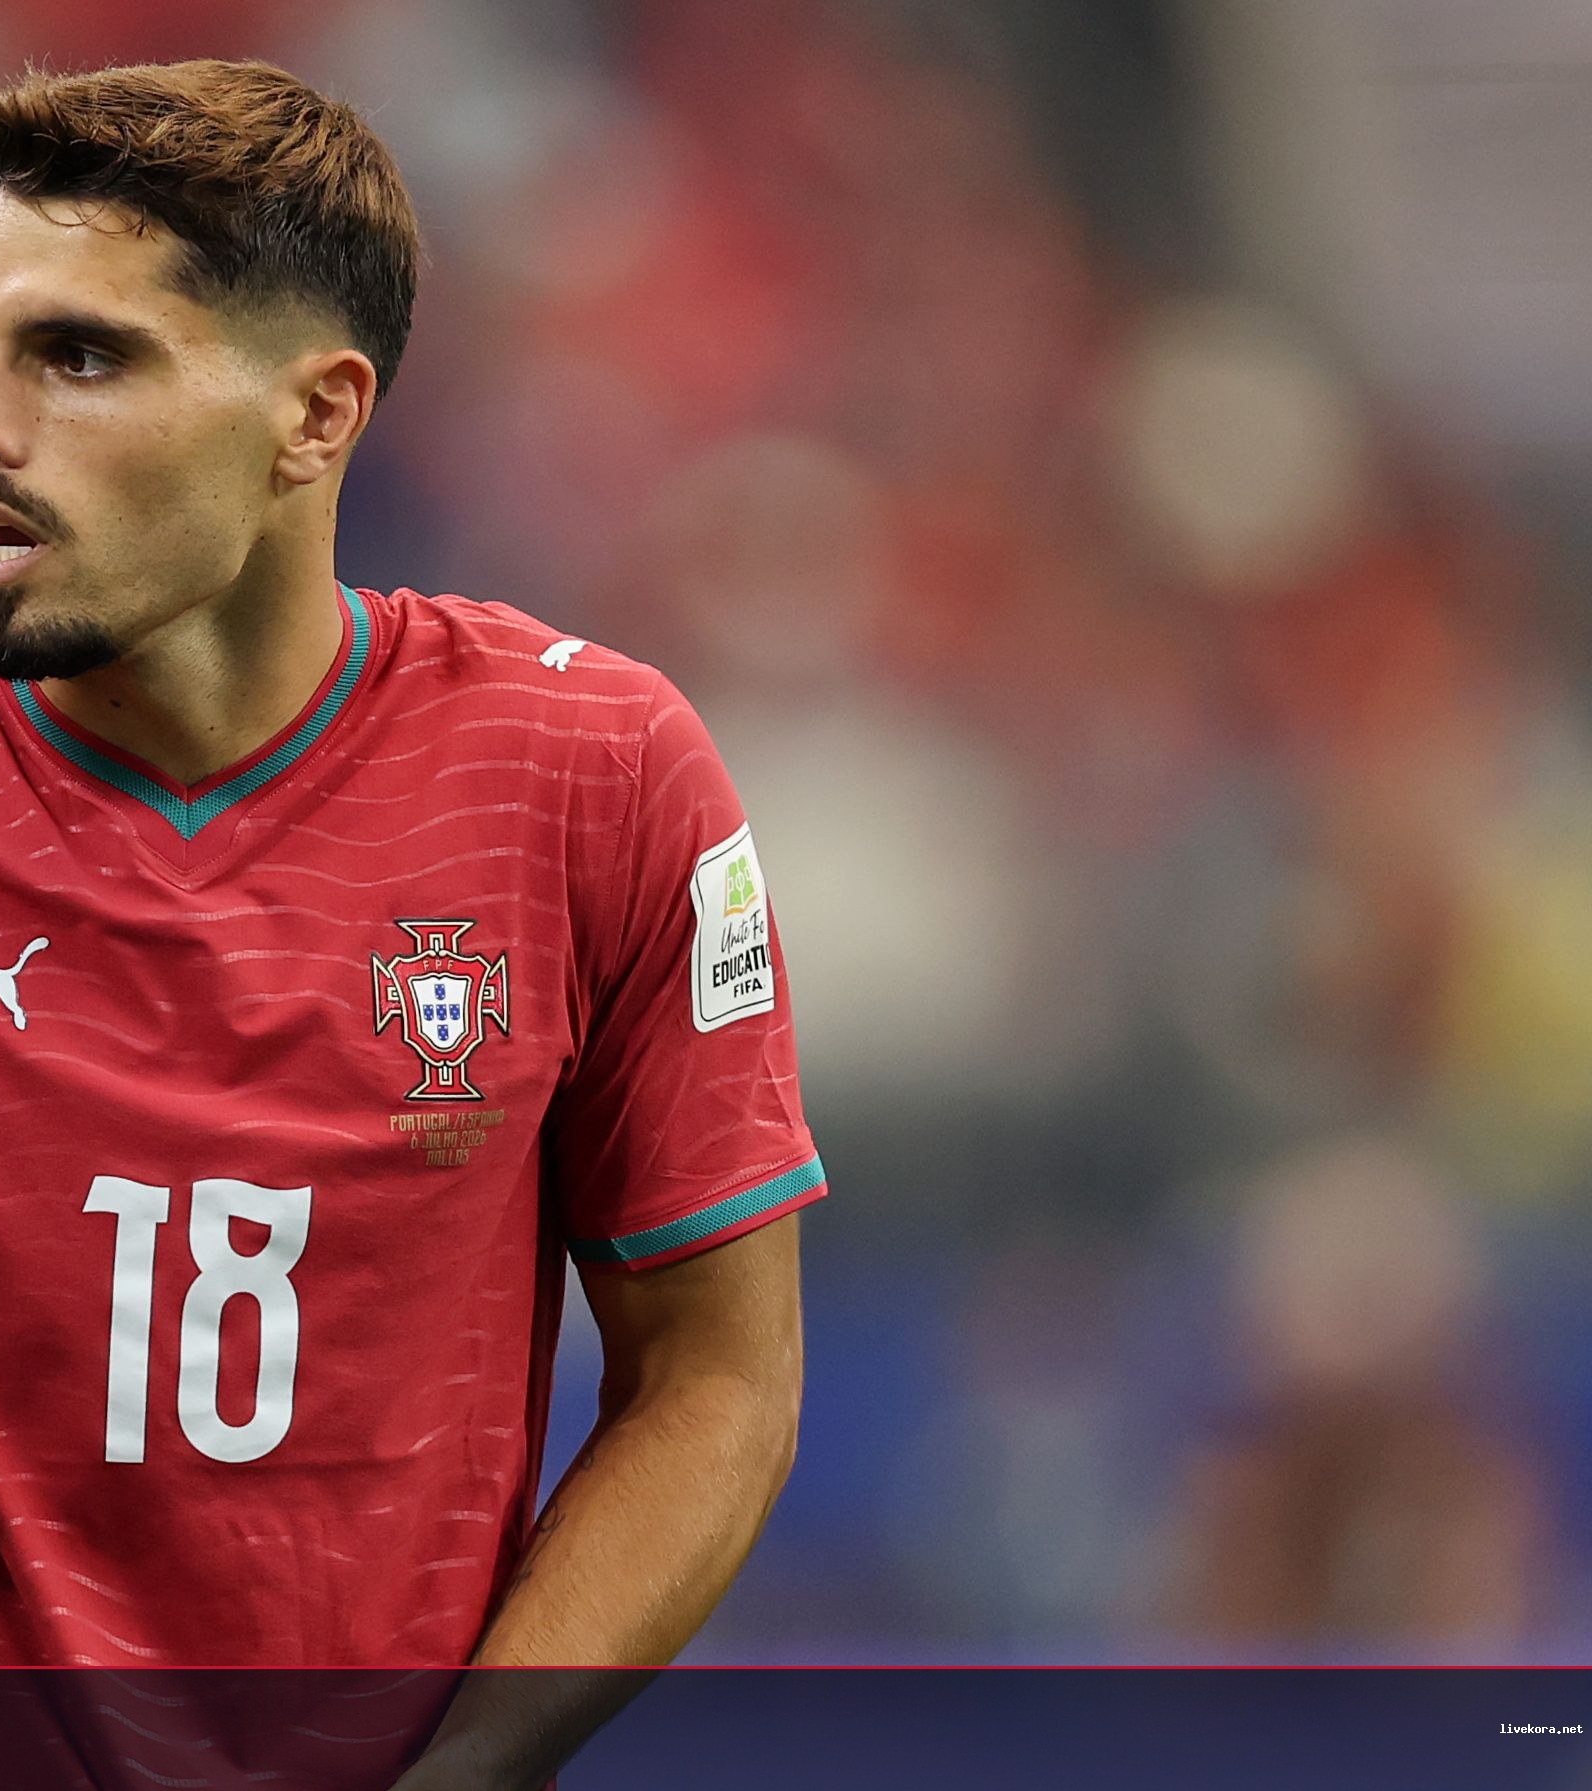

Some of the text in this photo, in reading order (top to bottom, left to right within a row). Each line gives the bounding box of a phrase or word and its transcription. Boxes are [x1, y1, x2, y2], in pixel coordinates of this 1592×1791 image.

[721, 918, 749, 954] Unite
[422, 959, 455, 972] FPF
[733, 977, 763, 998] FIFA
[411, 1129, 488, 1150] 6 JULHO 2026
[425, 1148, 471, 1167] DALLAS
[81, 1174, 313, 1464] 18
